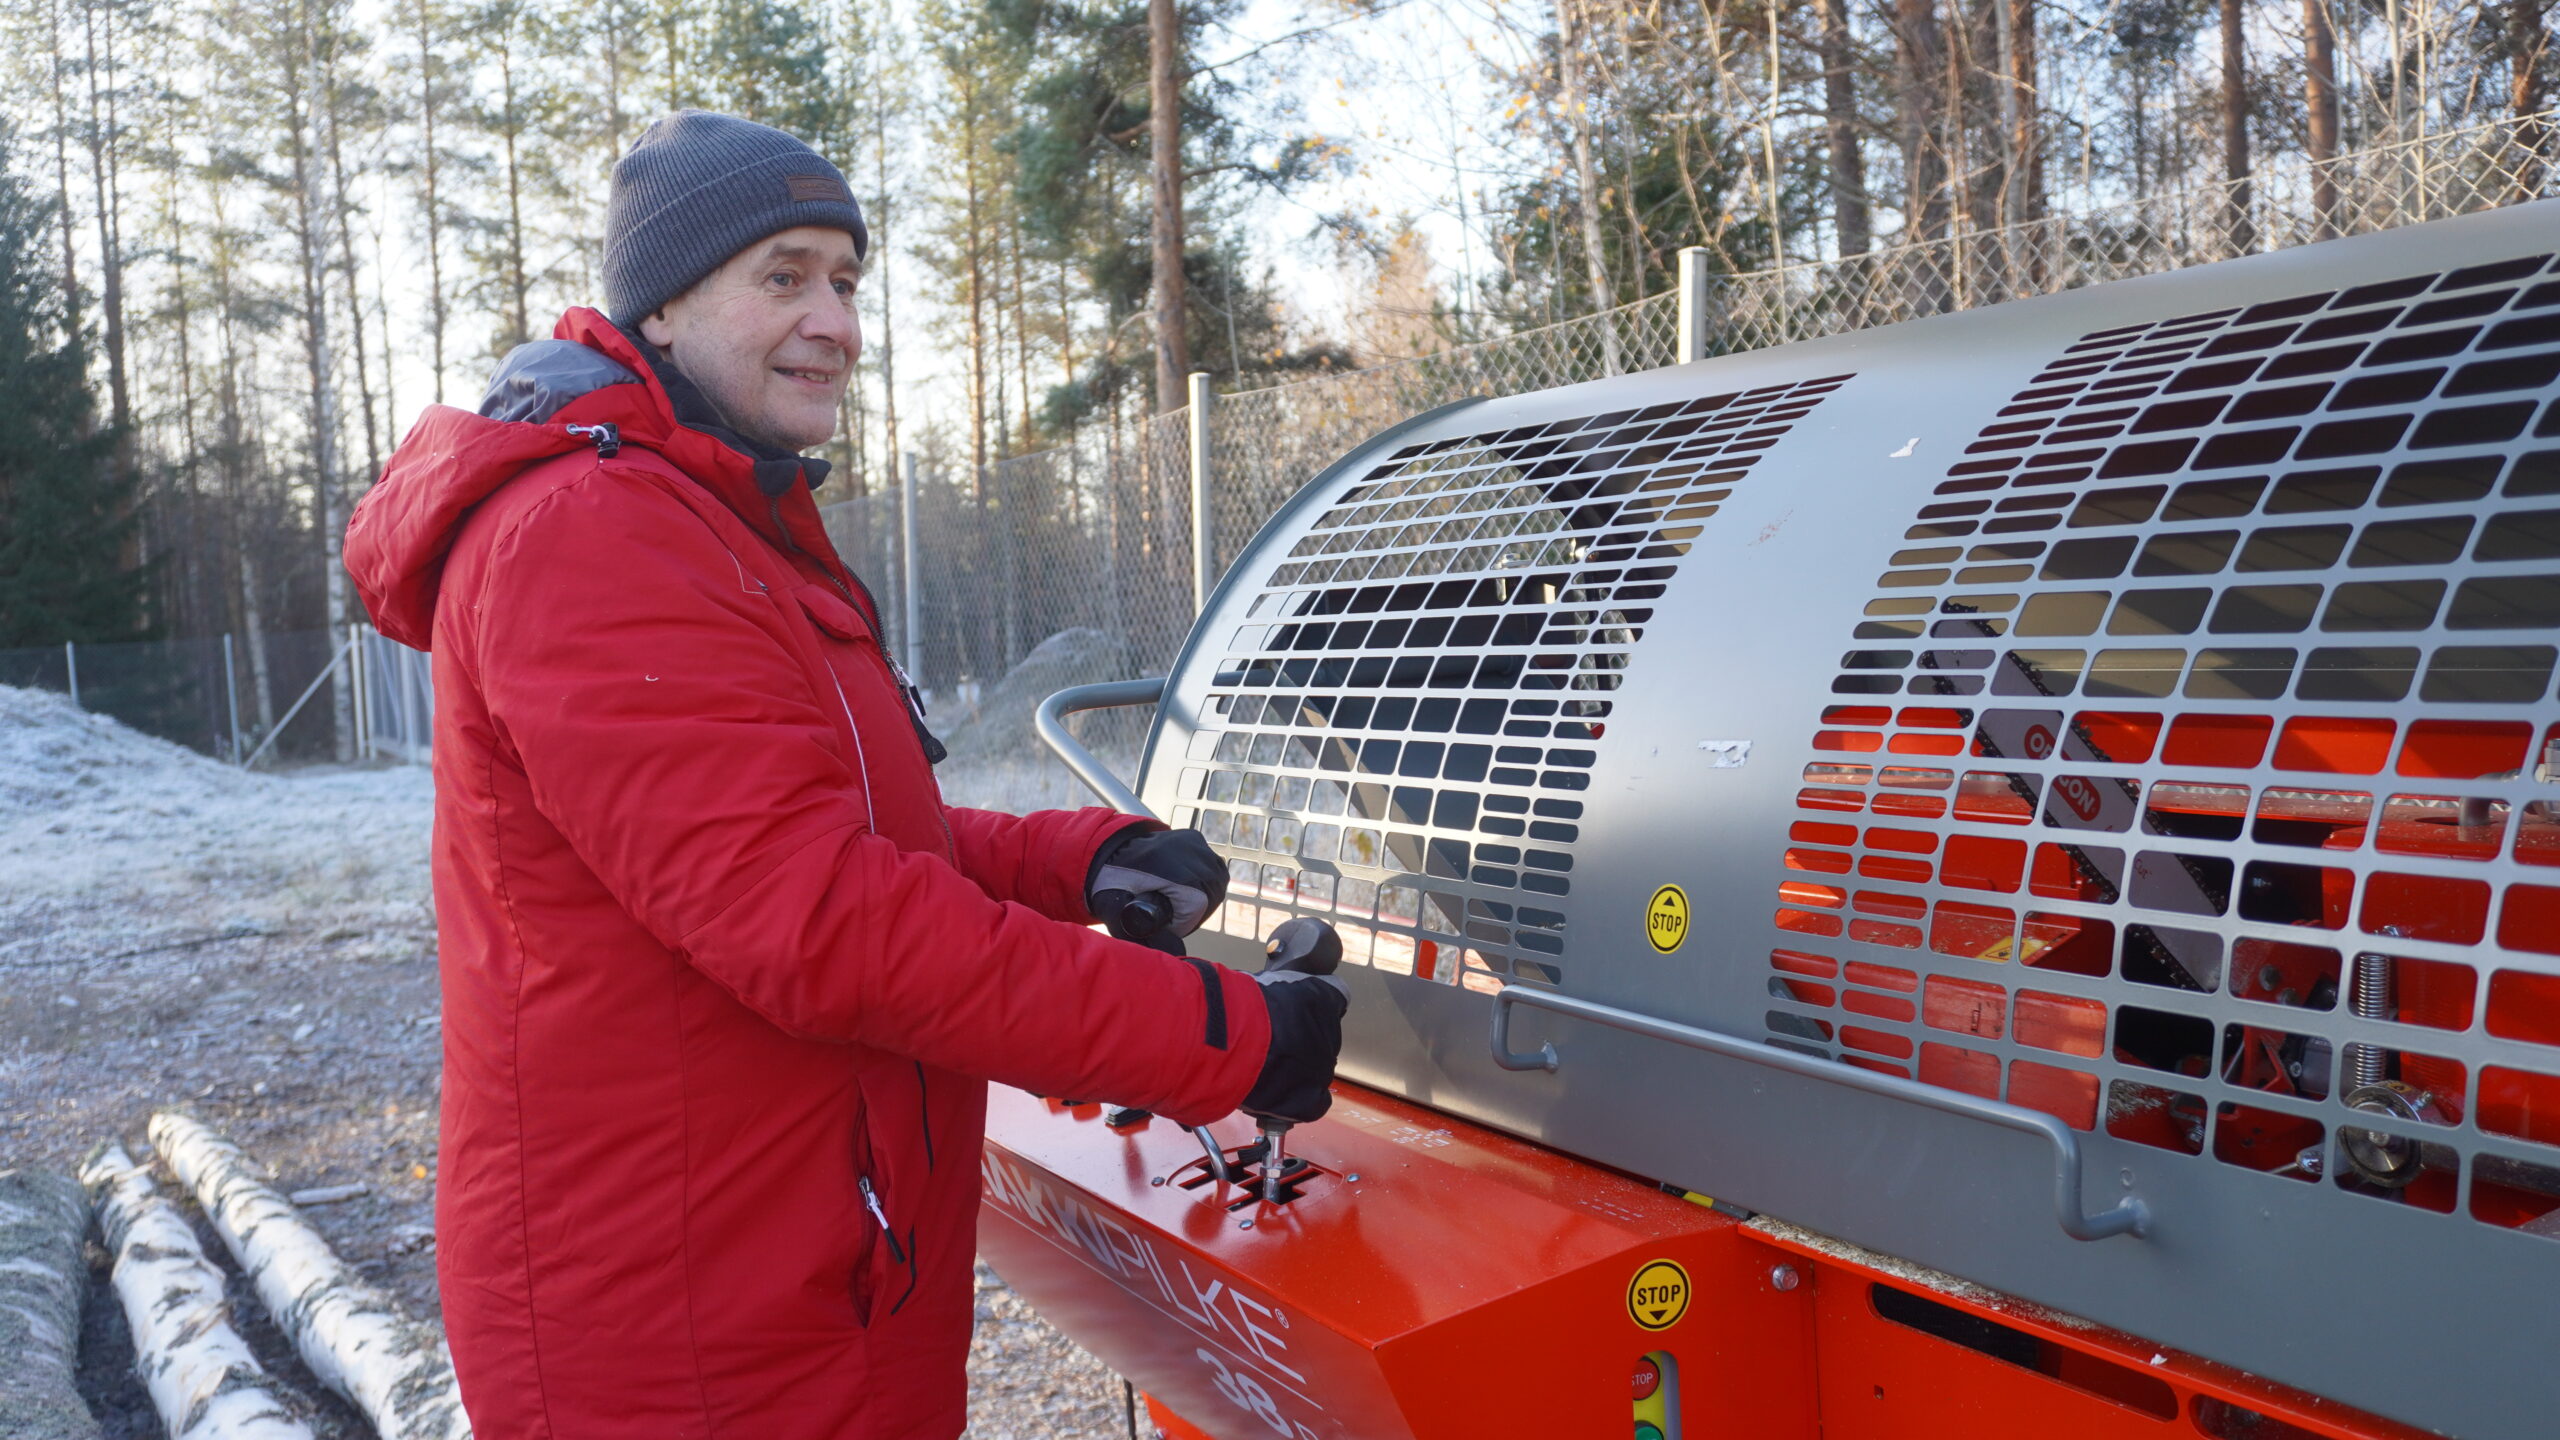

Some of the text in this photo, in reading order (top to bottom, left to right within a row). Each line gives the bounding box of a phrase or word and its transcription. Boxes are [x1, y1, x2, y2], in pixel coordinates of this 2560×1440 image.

[2030, 733, 2095, 813] OON
[1652, 912, 1682, 933] STOP
[1637, 1284, 1681, 1306] STOP
